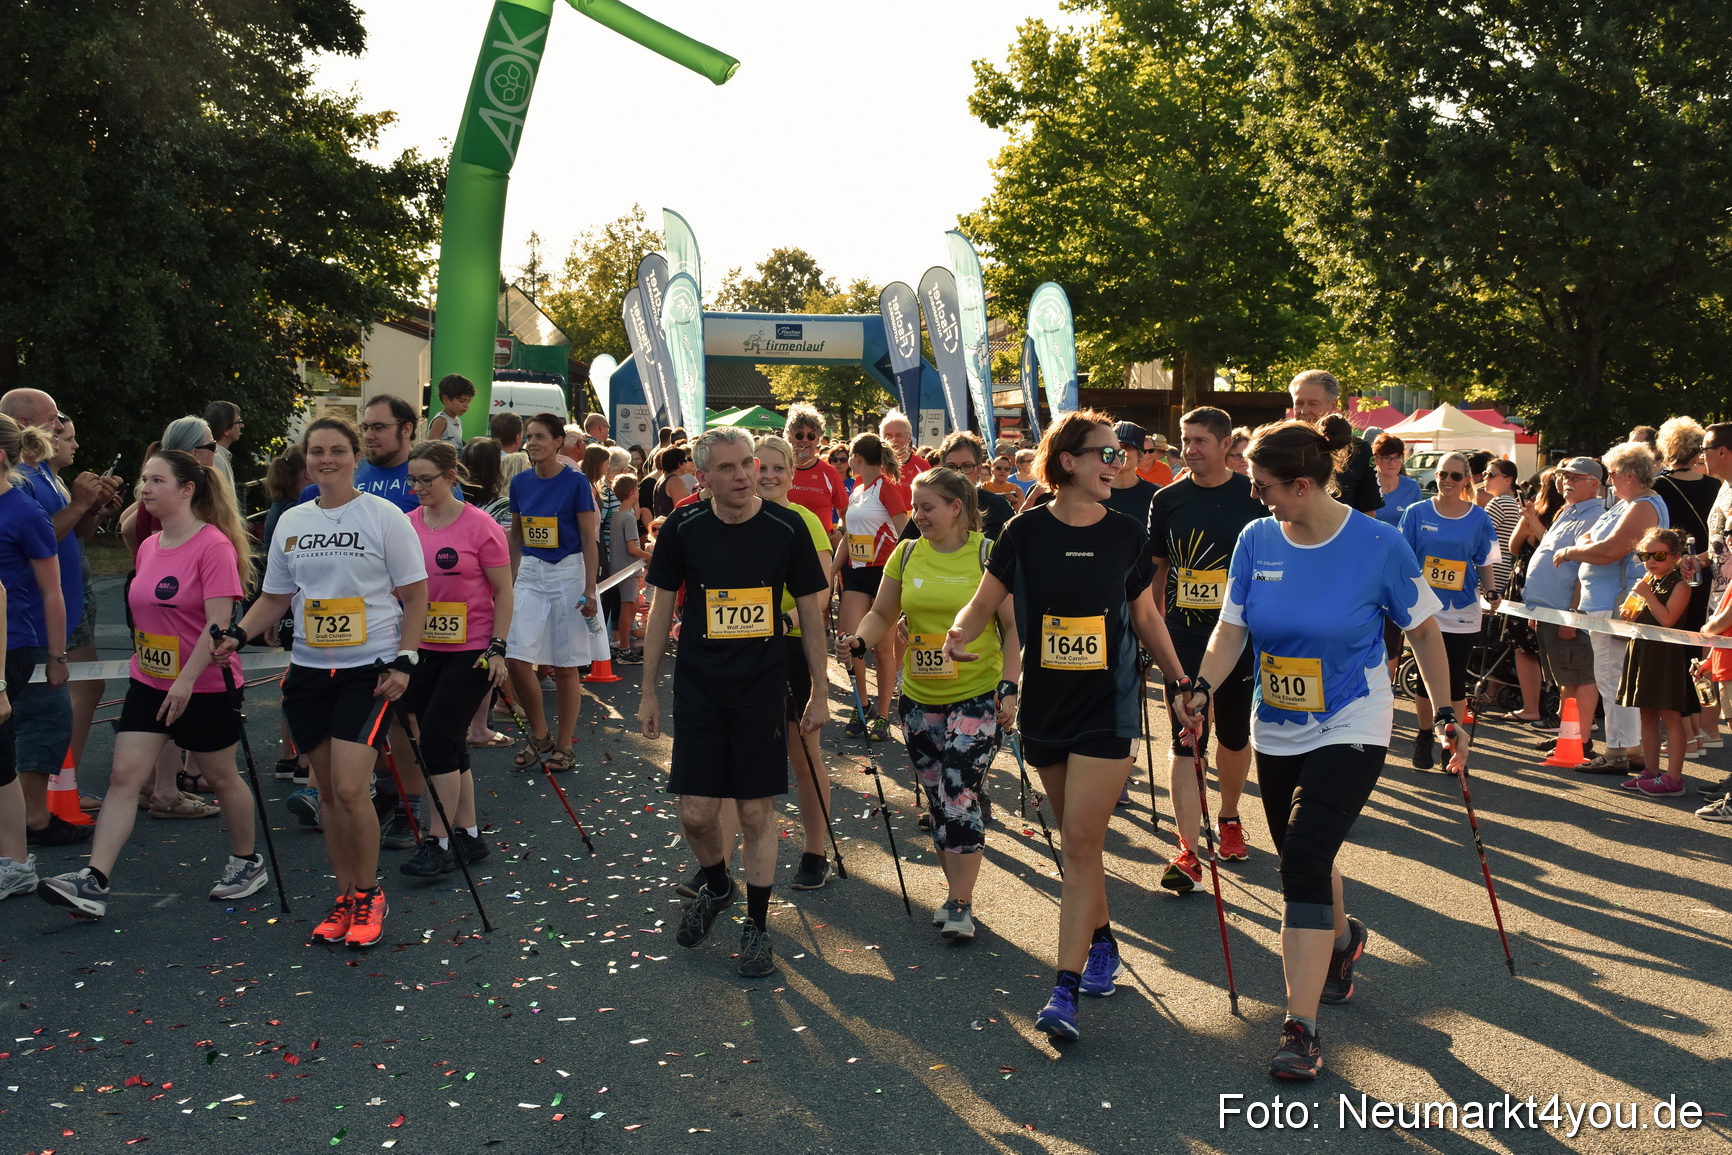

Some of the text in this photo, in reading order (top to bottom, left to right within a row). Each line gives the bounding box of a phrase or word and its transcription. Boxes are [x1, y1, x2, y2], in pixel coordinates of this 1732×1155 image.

[478, 10, 547, 160] AOK
[766, 340, 826, 352] firmenlauf
[298, 532, 365, 550] GRADL
[529, 528, 548, 539] 655
[850, 544, 865, 554] 111
[1431, 568, 1456, 581] 816
[1183, 583, 1218, 598] 1421
[715, 605, 764, 624] 1702
[314, 615, 351, 633] 732
[1048, 635, 1097, 655] 1646
[138, 645, 171, 667] 1440
[916, 650, 943, 666] 935
[1269, 674, 1306, 696] 810
